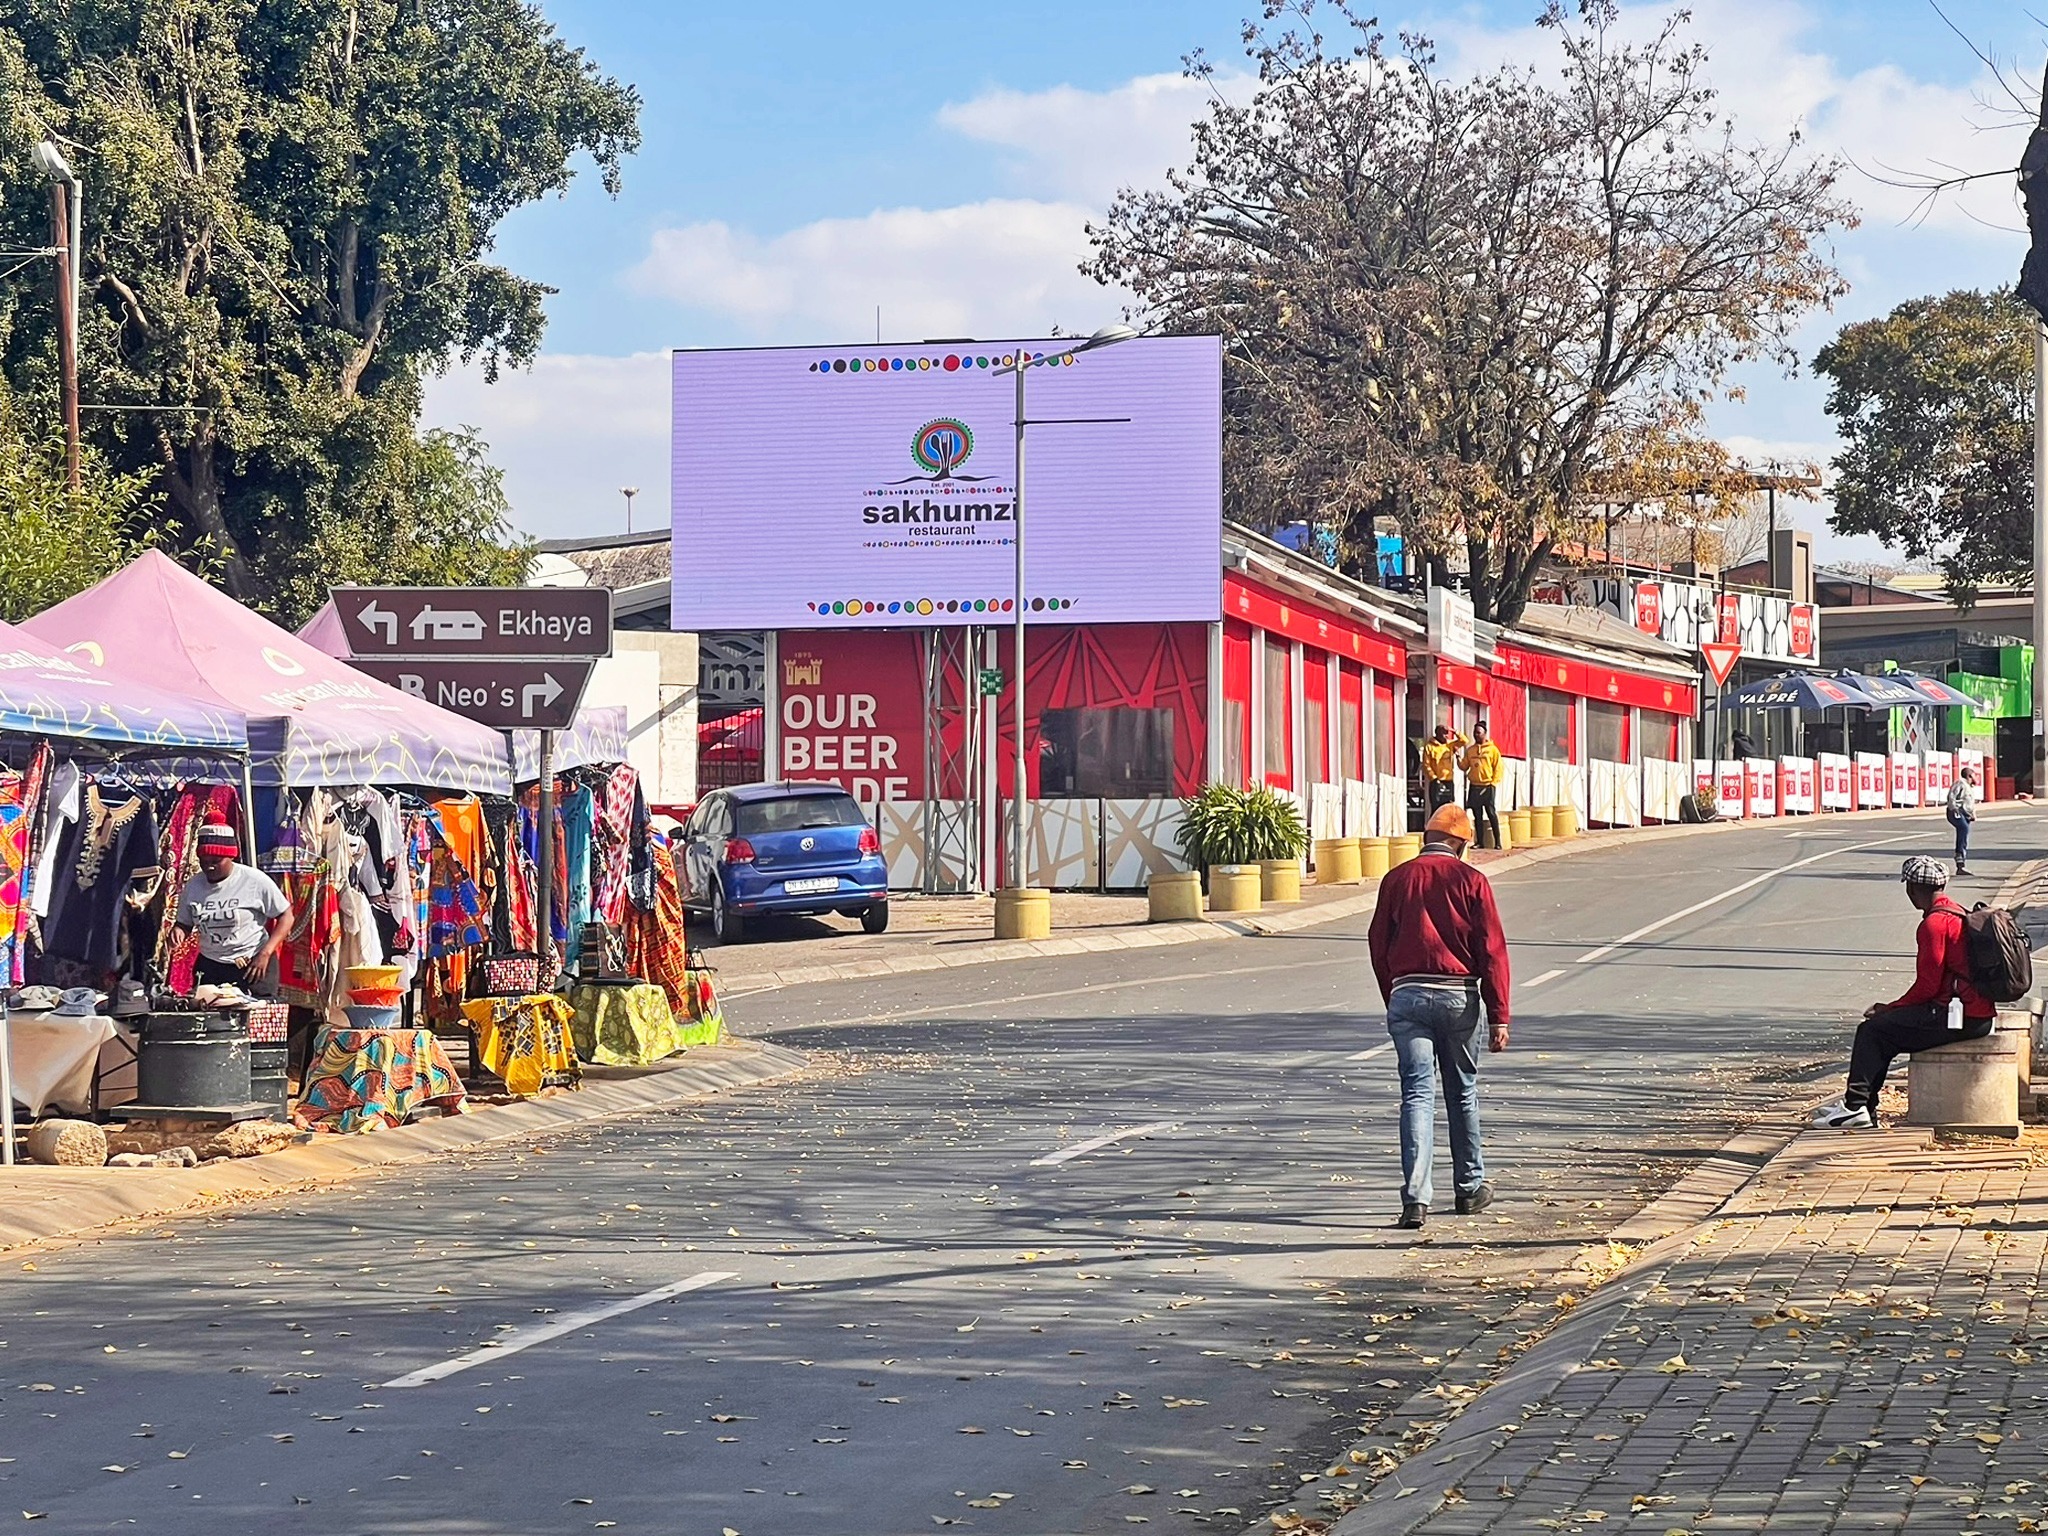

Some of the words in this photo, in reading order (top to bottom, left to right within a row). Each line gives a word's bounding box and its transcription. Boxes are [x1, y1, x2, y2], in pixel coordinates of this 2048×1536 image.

[908, 524, 976, 536] restaurant
[1639, 593, 1657, 607] nex
[498, 610, 593, 642] Ekhaya
[1793, 615, 1809, 628] nex
[438, 681, 515, 707] Neo's
[1739, 689, 1799, 704] VALPRÉ
[783, 694, 878, 729] OUR
[784, 735, 898, 771] BEER
[1723, 778, 1740, 787] nex
